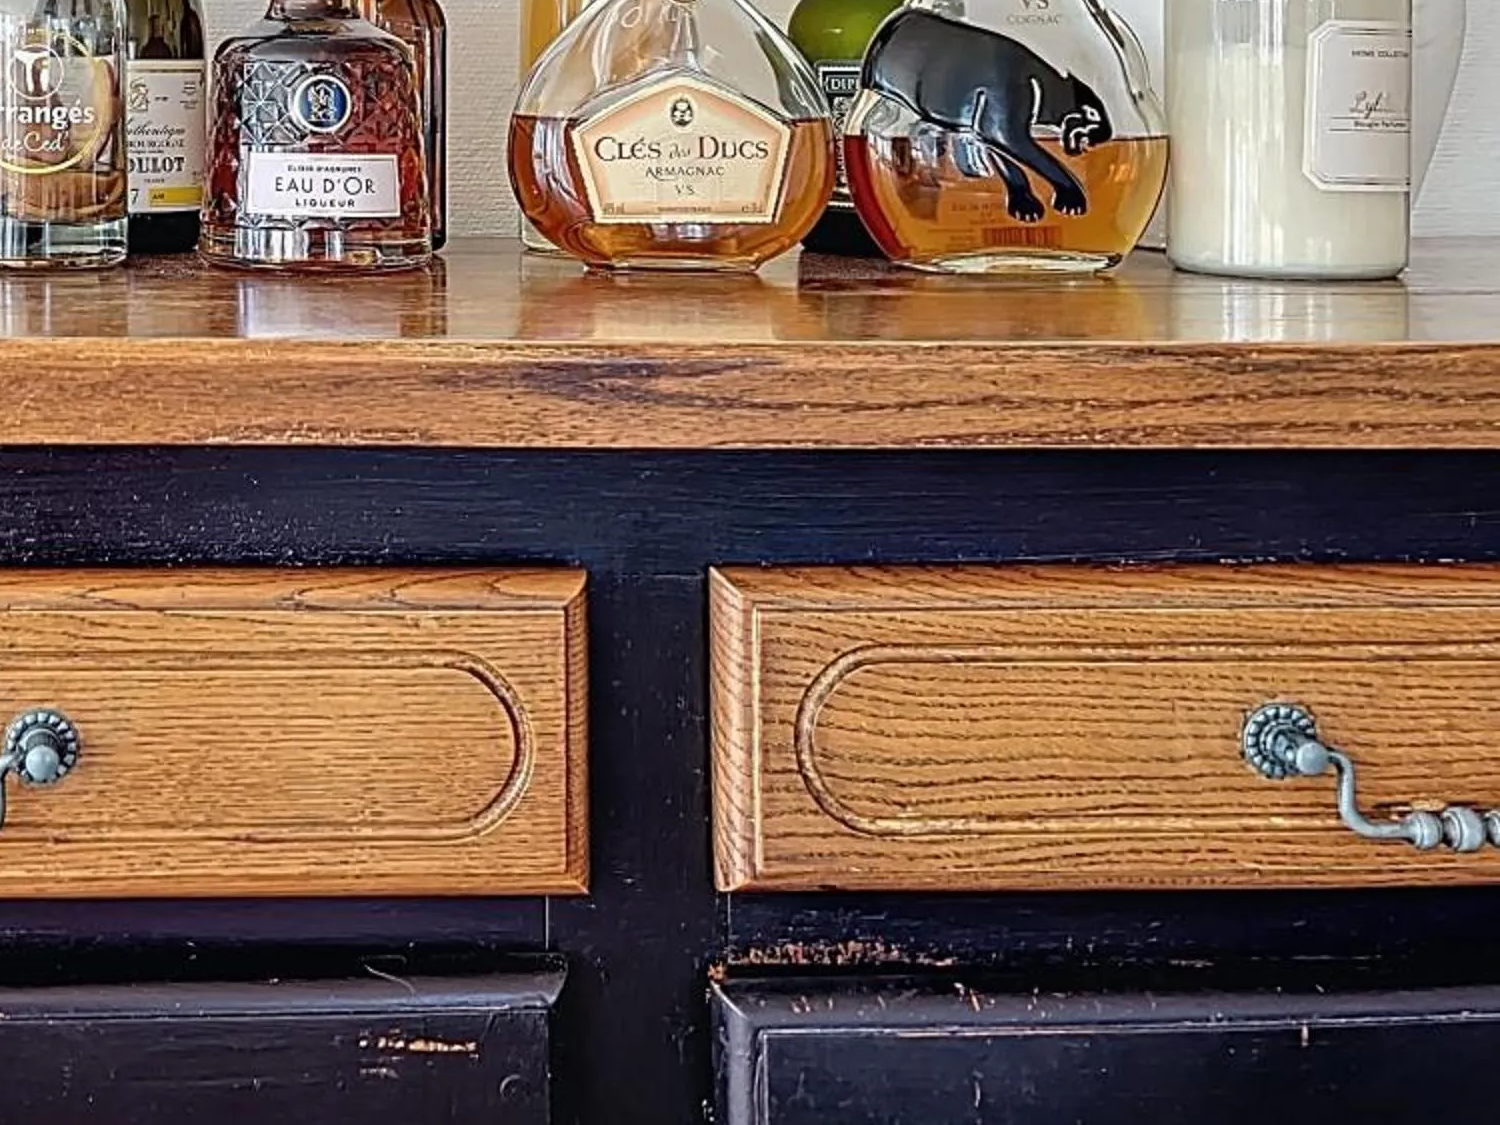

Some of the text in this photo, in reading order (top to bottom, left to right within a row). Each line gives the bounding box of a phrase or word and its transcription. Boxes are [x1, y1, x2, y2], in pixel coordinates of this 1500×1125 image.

[645, 166, 725, 181] ARMAGNAC
[275, 176, 377, 196] EAU D'OR
[295, 198, 356, 208] LIQUEUR
